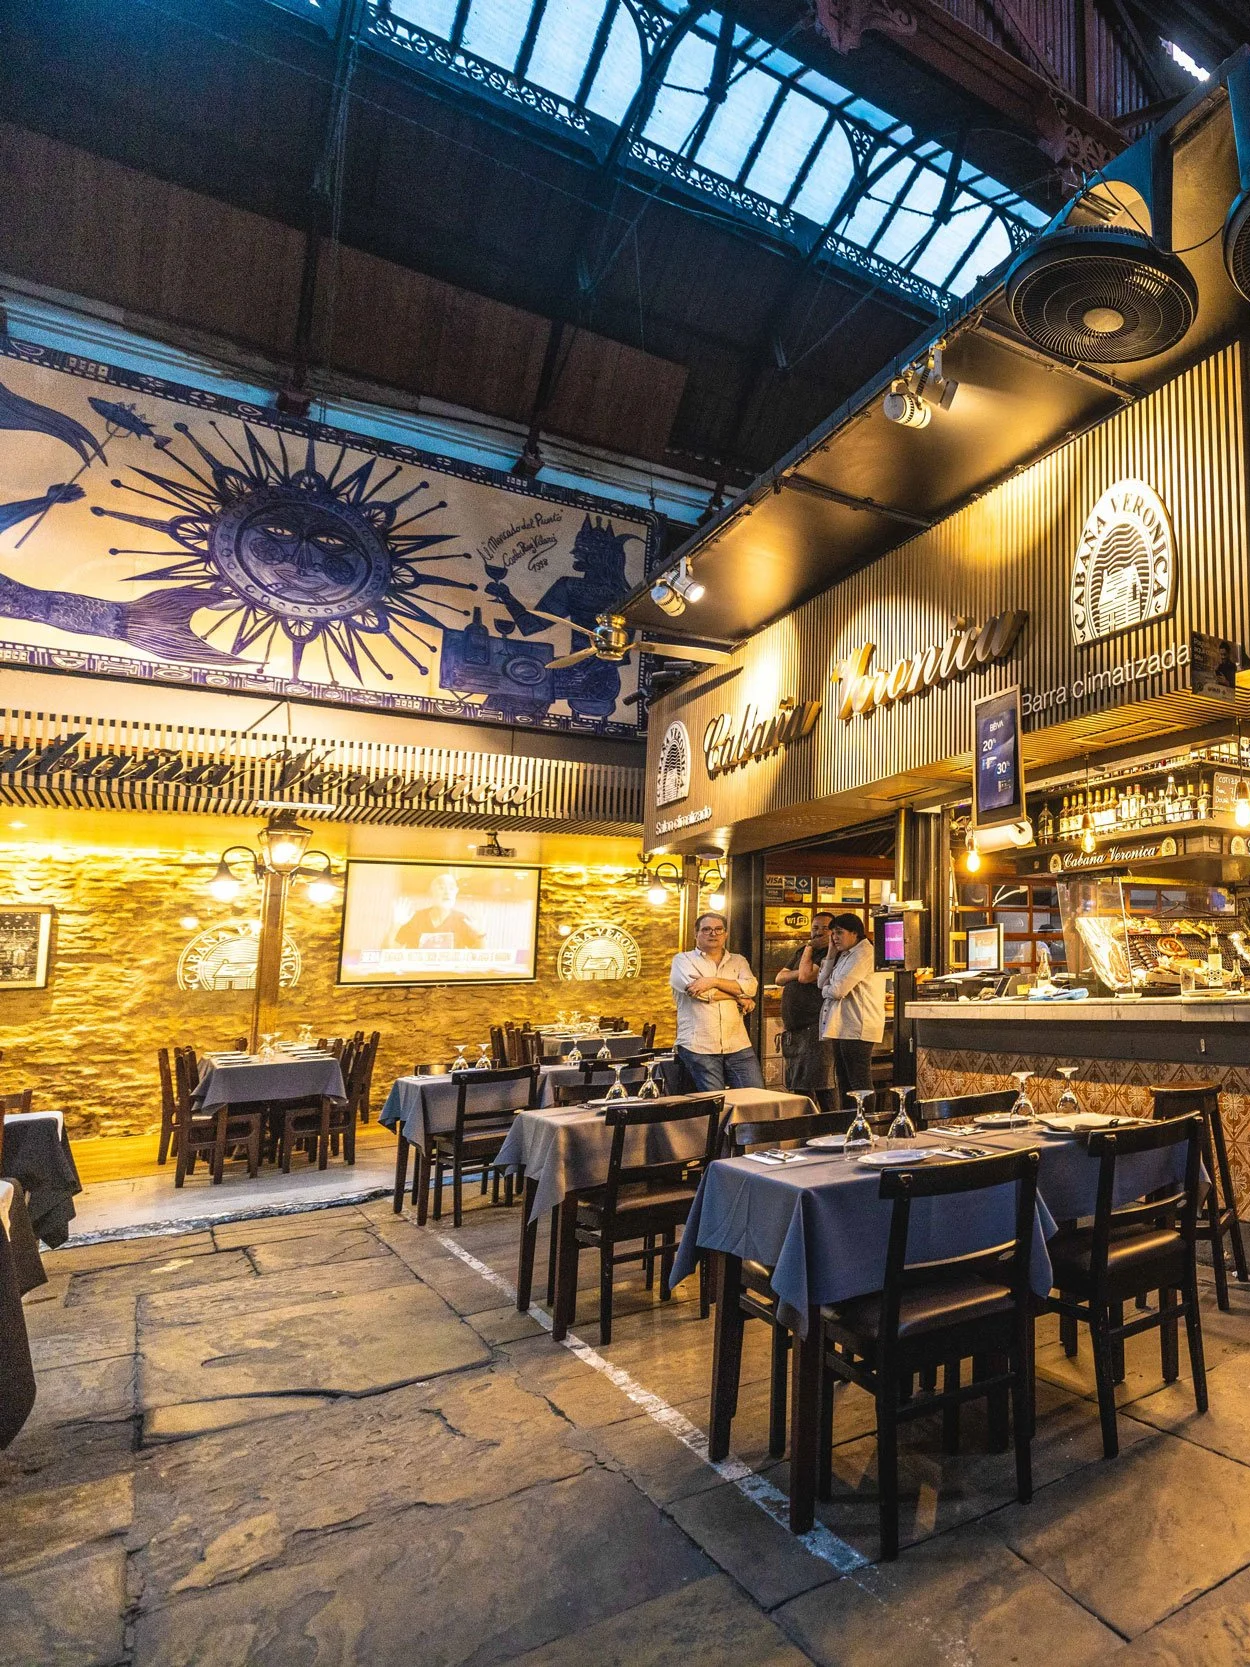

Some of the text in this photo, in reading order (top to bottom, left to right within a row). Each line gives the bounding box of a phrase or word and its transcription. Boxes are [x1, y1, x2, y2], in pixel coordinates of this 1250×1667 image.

[1110, 492, 1167, 599] VERONICA
[831, 608, 1029, 720] Veronica
[1072, 642, 1191, 699] climatizada
[989, 719, 1005, 732] BBVA
[264, 748, 546, 806] Veronica
[766, 876, 783, 885] VISA
[1062, 844, 1158, 868] Cabaña Veronica
[595, 928, 637, 975] VERONICA
